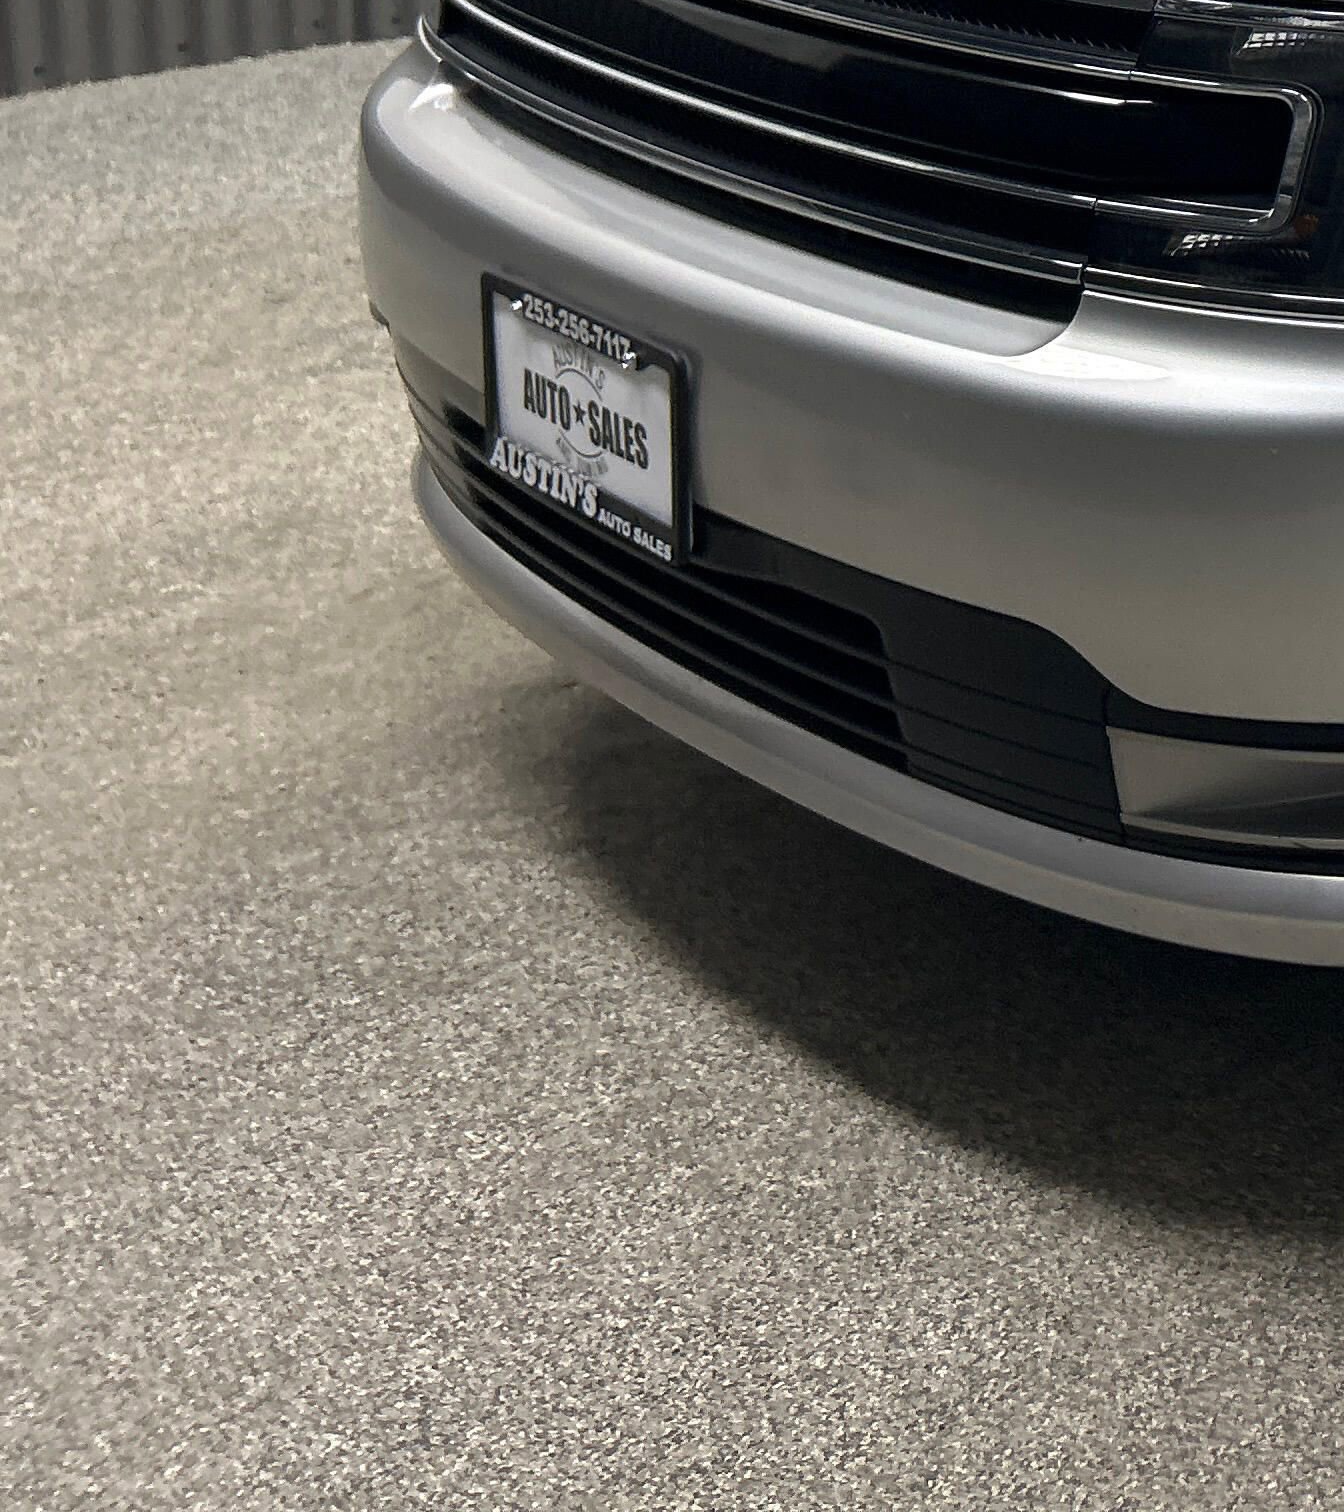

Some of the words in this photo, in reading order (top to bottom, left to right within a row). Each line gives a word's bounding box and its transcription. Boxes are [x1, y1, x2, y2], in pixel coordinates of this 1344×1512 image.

[523, 368, 571, 431] AUTO
[587, 400, 650, 470] SALES
[490, 437, 599, 519] AUSTIN'S
[600, 508, 631, 538] AUTO
[633, 526, 672, 562] SALES
